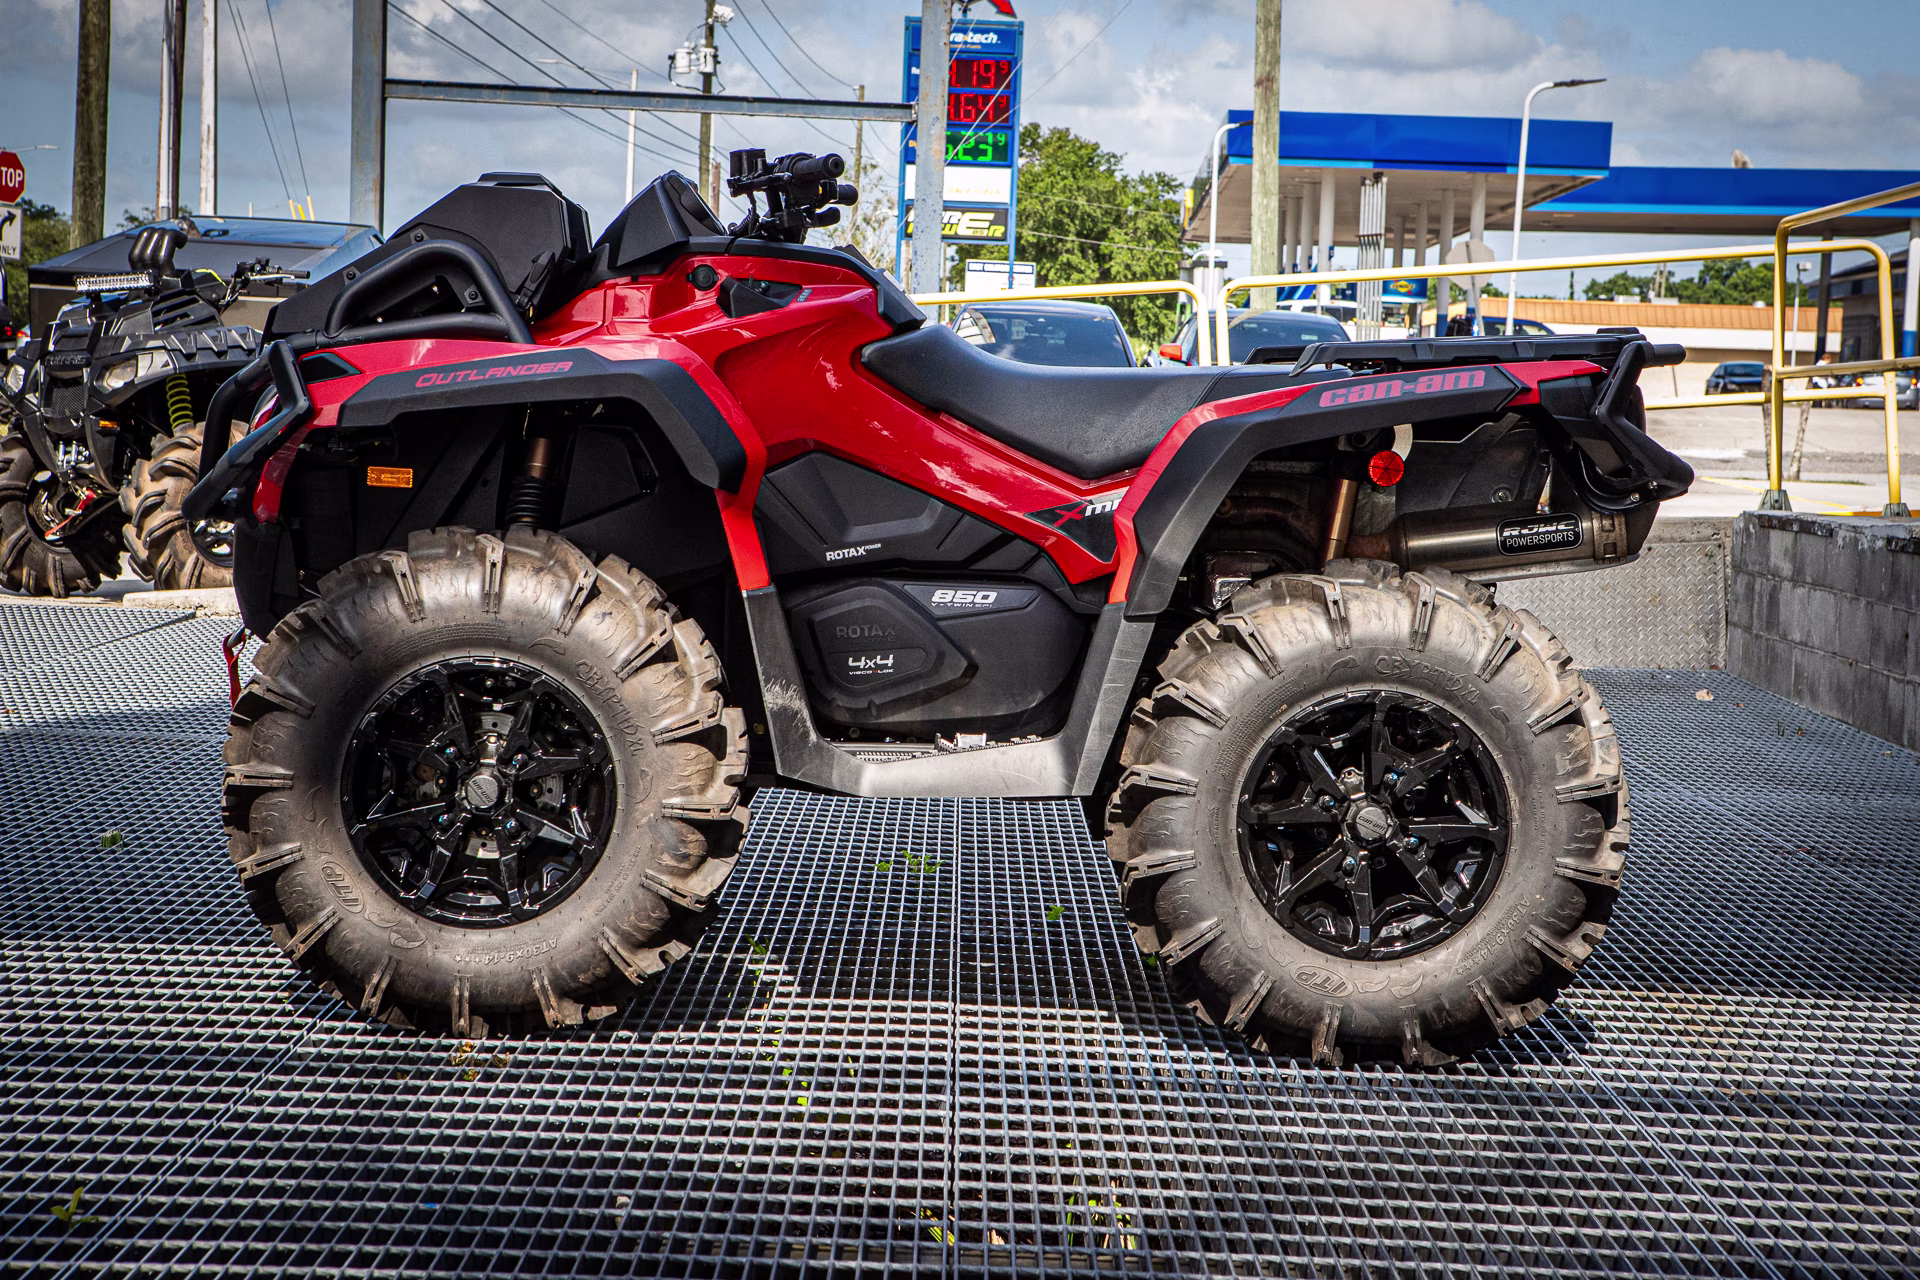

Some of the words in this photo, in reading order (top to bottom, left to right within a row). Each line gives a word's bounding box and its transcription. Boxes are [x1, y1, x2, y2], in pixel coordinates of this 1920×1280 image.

[0, 167, 23, 188] TOP
[0, 244, 17, 256] NLY
[415, 361, 574, 388] OUTLANDER
[1319, 370, 1486, 407] can-am
[1503, 520, 1576, 537] RJWC
[1506, 531, 1575, 548] POWERSPORTS
[826, 546, 867, 561] ROTAX
[931, 589, 998, 603] 850
[836, 625, 896, 639] ROTAX
[848, 654, 894, 669] 4x4
[1357, 815, 1386, 832] can-am
[321, 865, 360, 906] ITP
[484, 937, 557, 966] AT30x9-14
[1295, 970, 1348, 996] ITP
